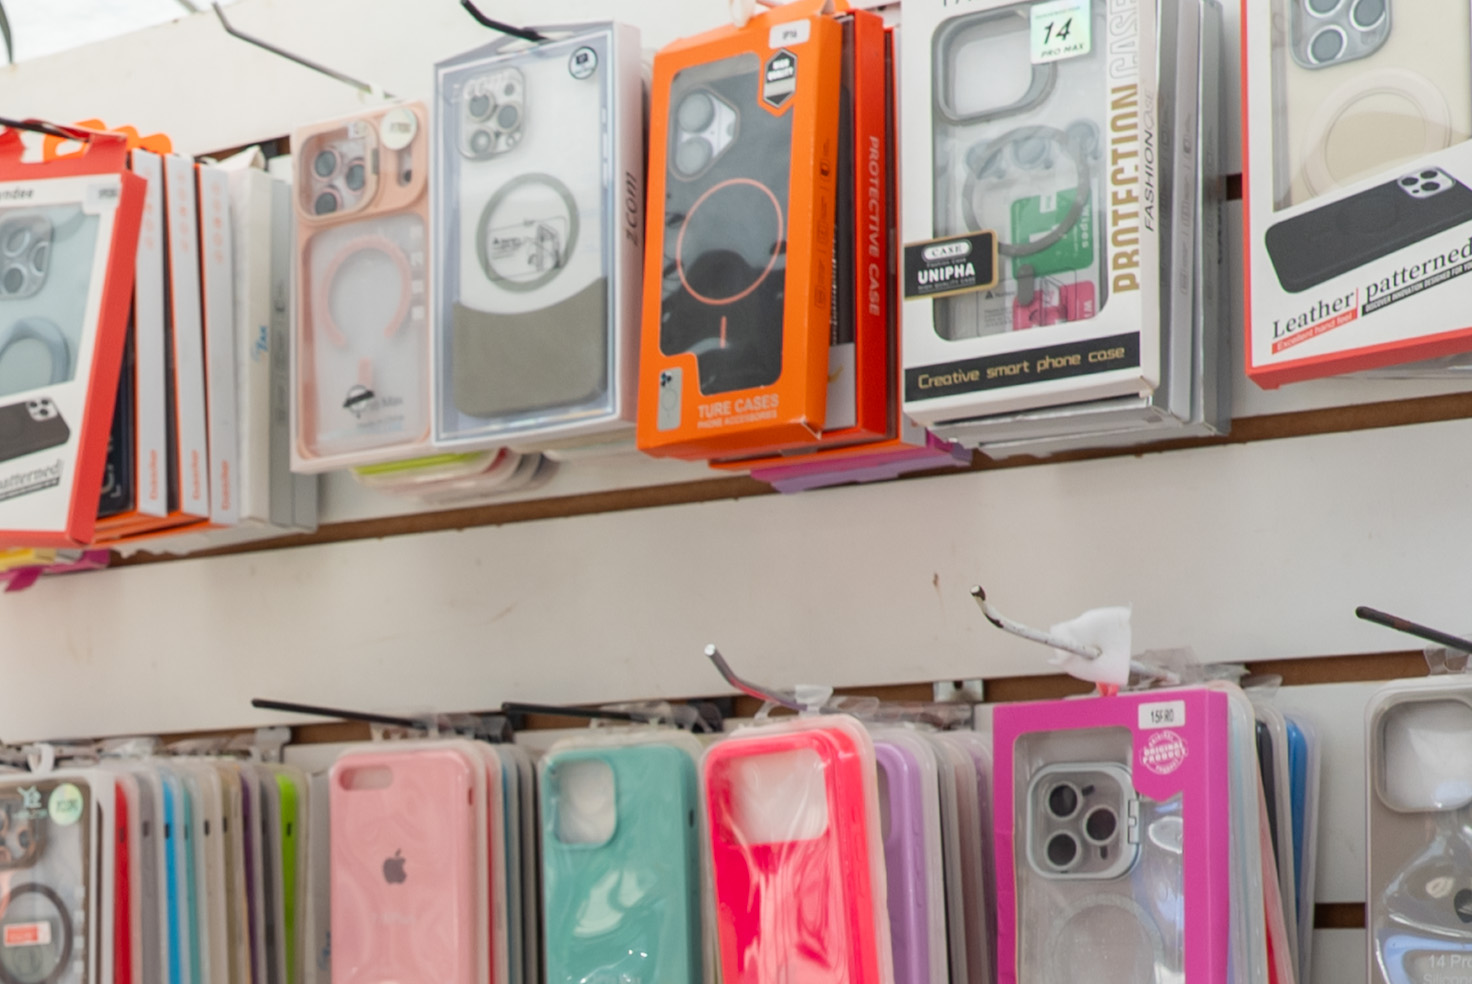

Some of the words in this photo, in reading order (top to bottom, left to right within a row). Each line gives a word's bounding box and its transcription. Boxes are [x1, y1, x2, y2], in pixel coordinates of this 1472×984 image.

[1043, 17, 1073, 45] 14
[1041, 48, 1062, 58] PRO
[1064, 43, 1085, 54] MAX
[867, 135, 881, 258] PROTECTIVE
[917, 262, 976, 285] UNIPHA
[868, 263, 881, 316] CASE
[1272, 291, 1354, 339] Leather
[918, 368, 980, 390] Creative
[986, 360, 1030, 378] smart
[1036, 352, 1081, 373] phone
[1088, 346, 1125, 363] case
[697, 400, 731, 419] TURE
[734, 394, 779, 413] CASES
[1430, 954, 1445, 969] 14
